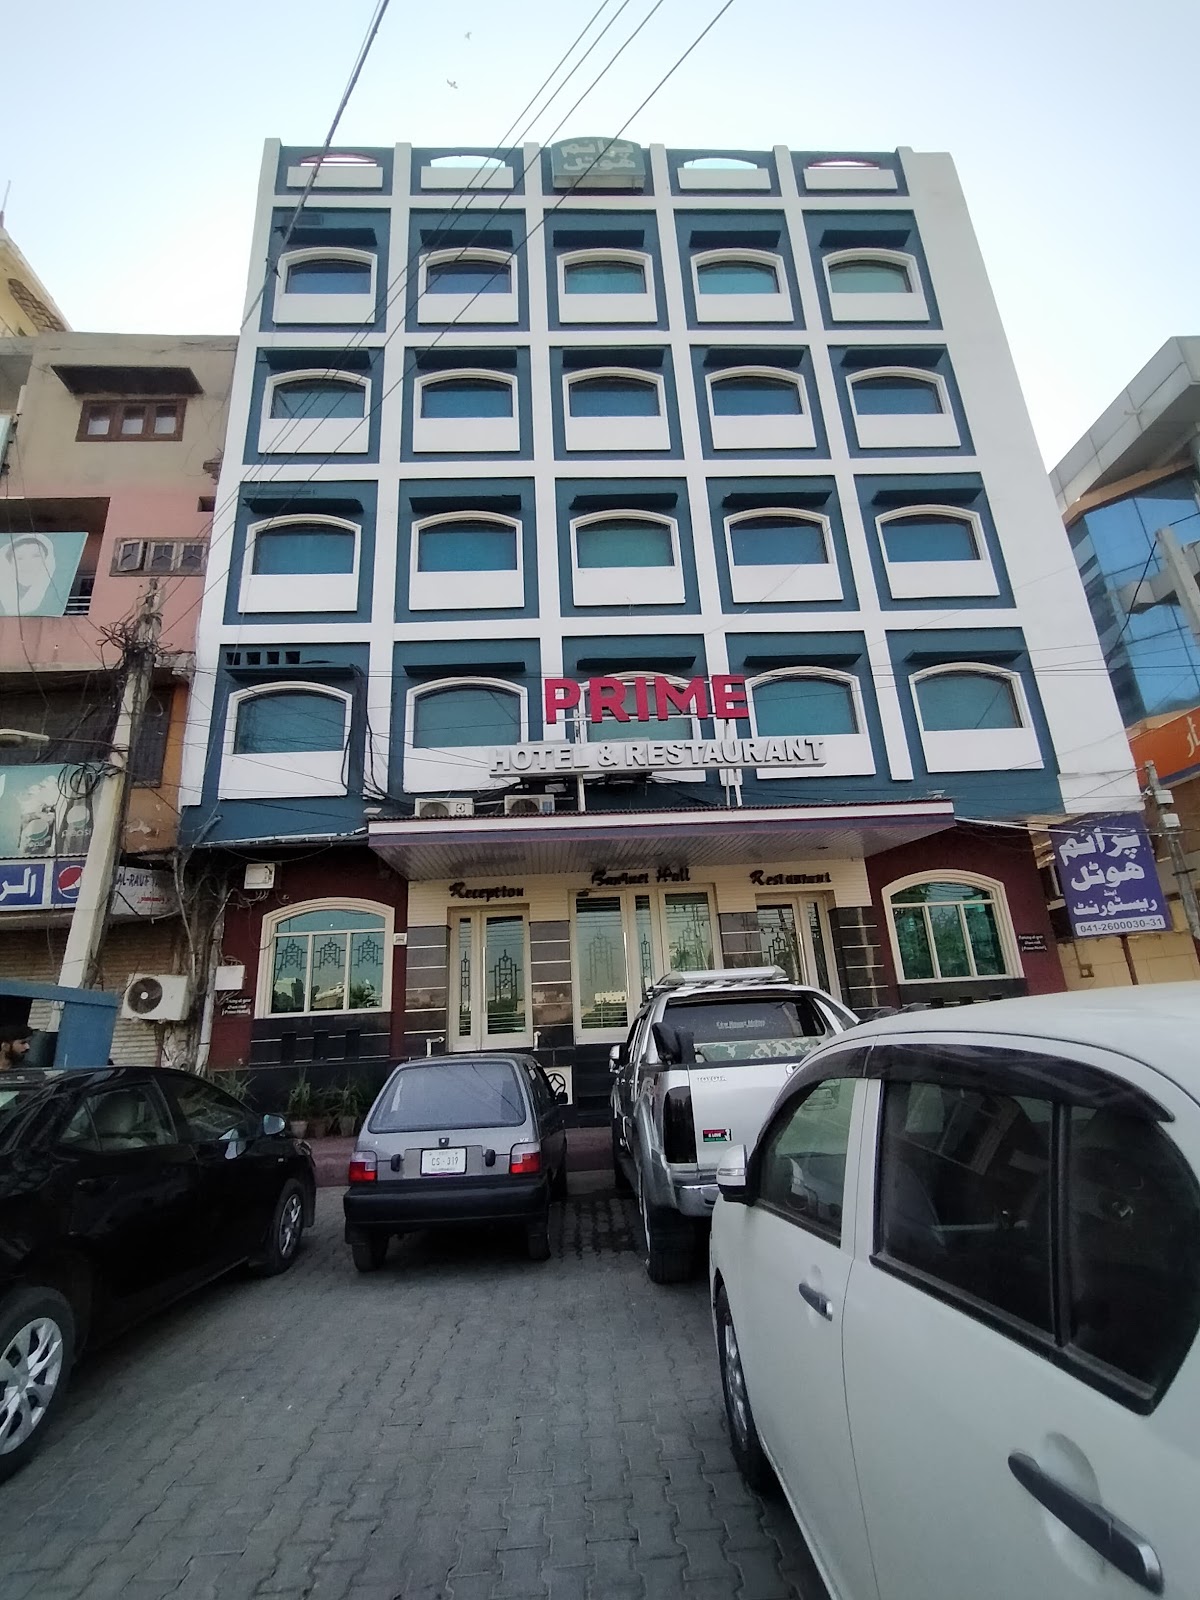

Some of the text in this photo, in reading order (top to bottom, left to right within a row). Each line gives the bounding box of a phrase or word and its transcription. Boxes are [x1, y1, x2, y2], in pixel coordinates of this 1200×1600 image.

[544, 674, 750, 725] PRIME
[490, 738, 824, 772] HOTEL & RESTAURANT
[448, 881, 524, 902] Reception
[1080, 918, 1162, 933] 041-2600030-31
